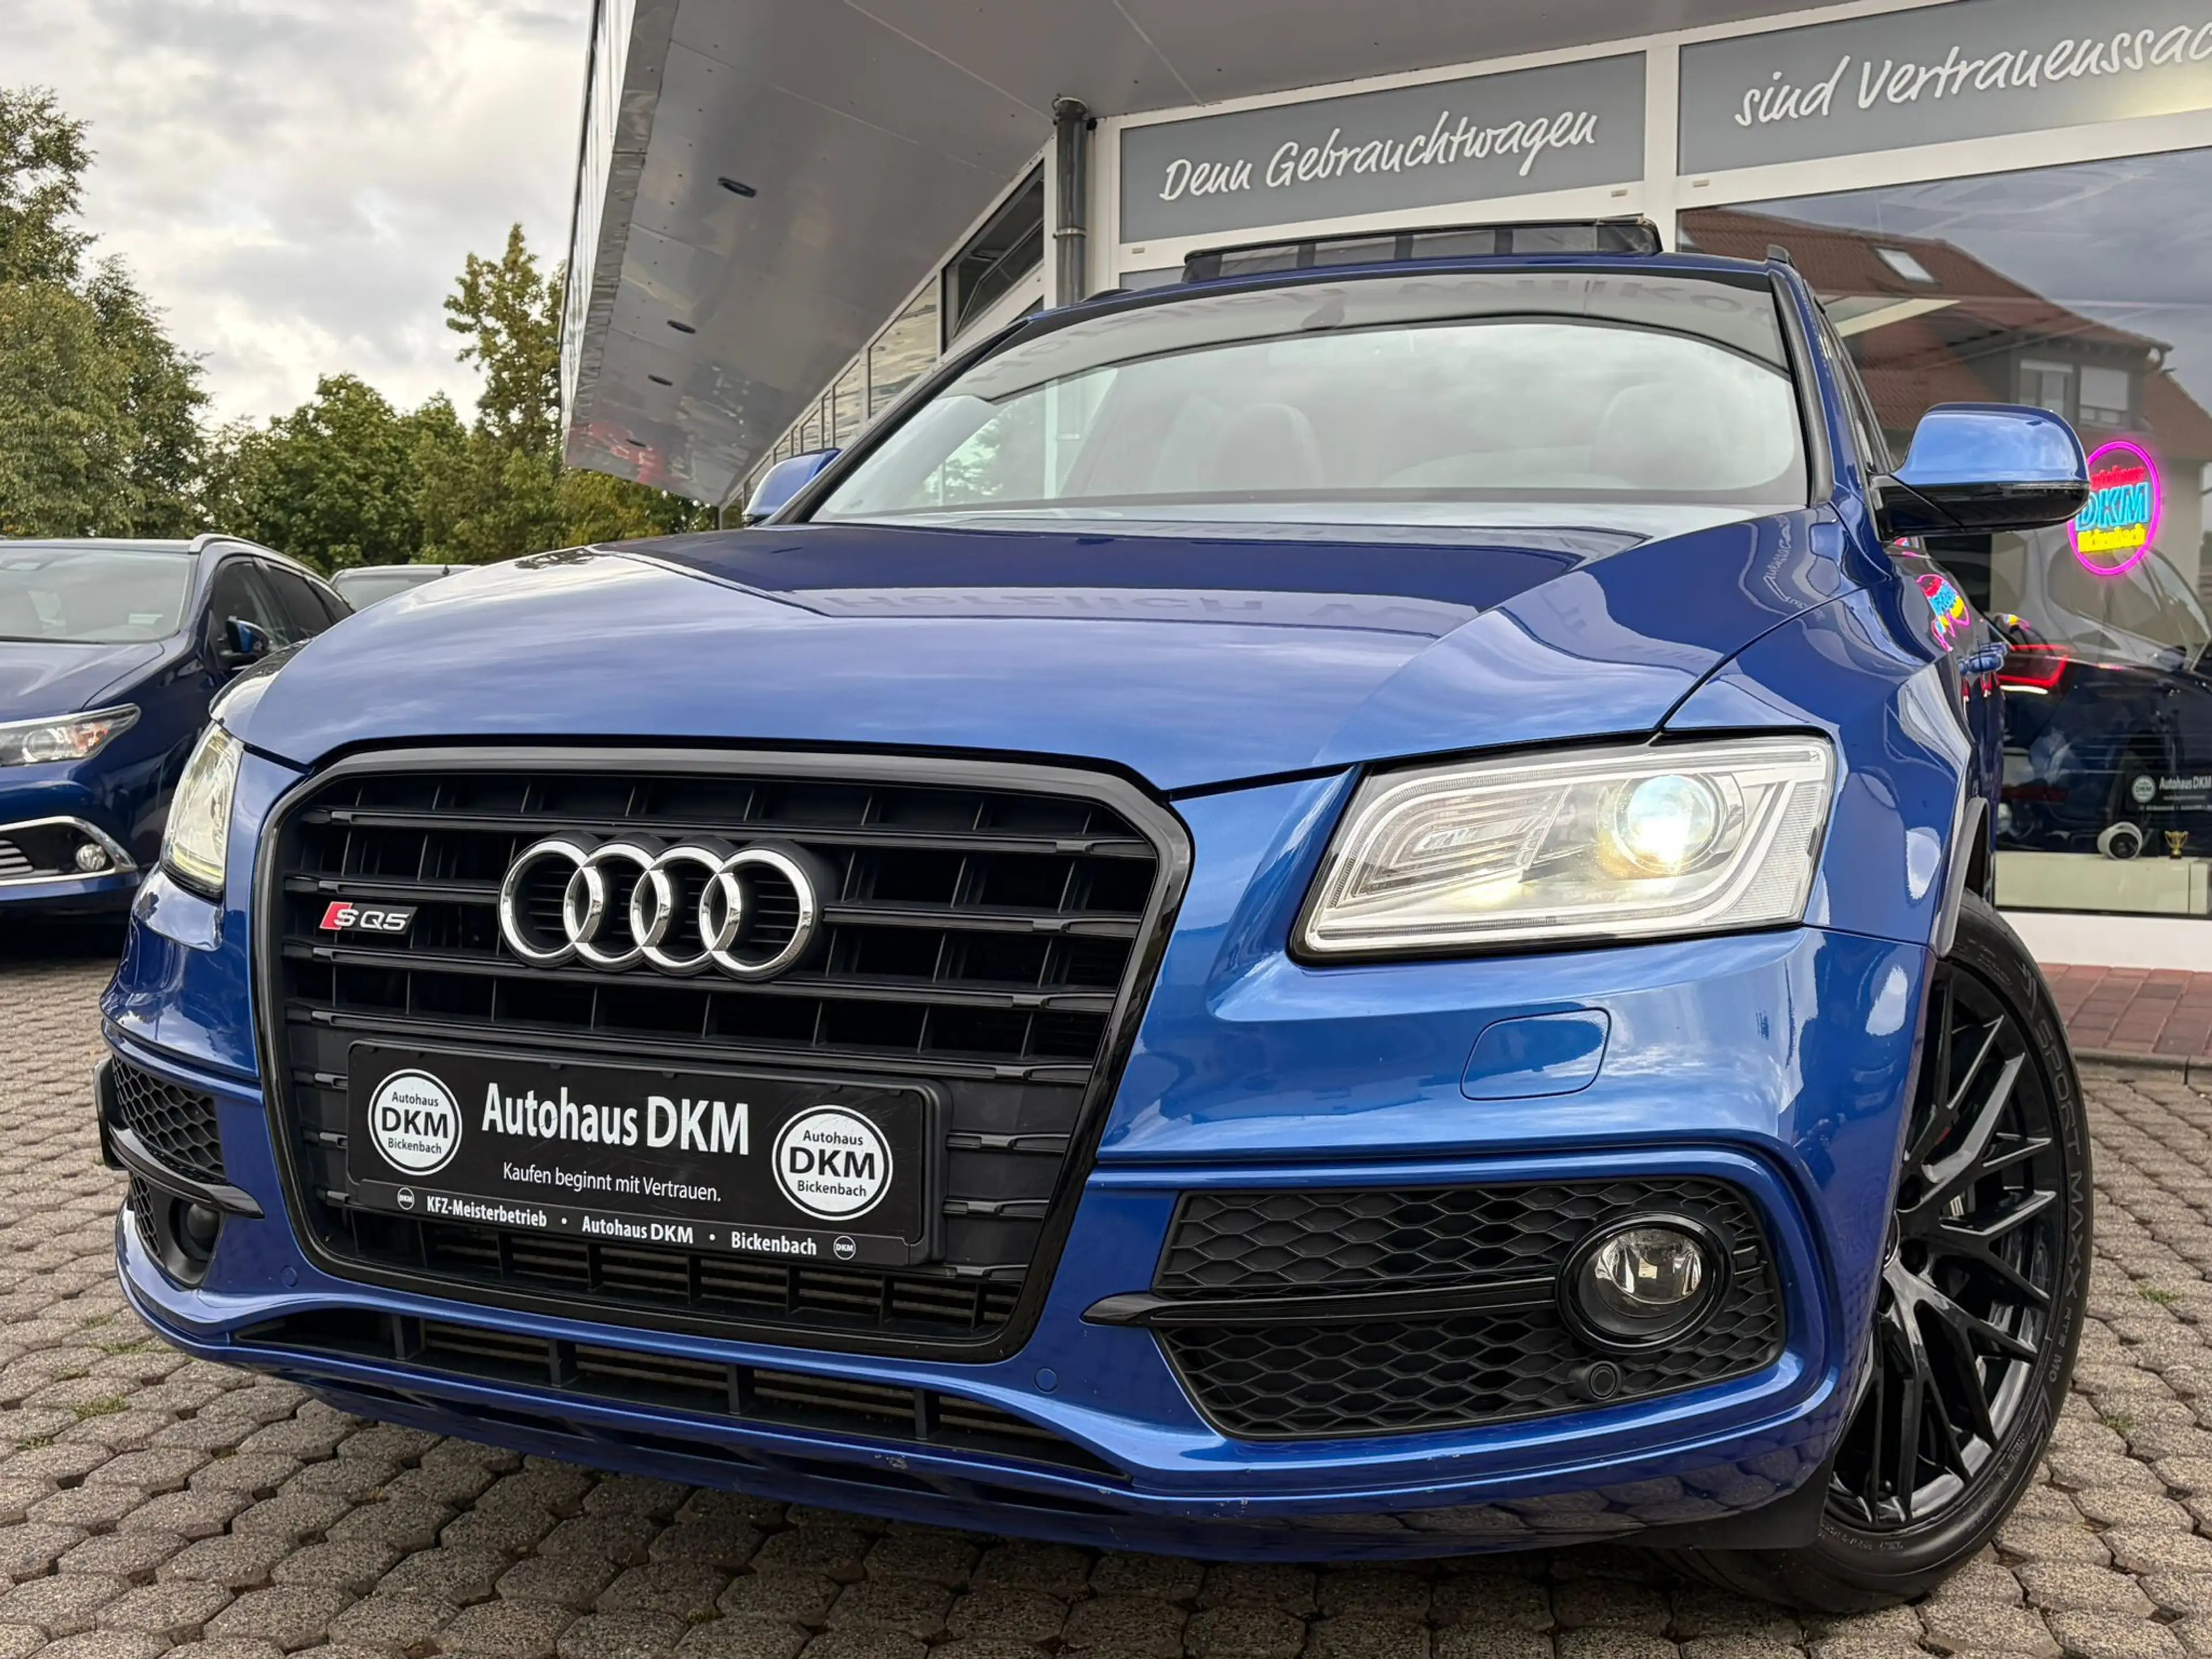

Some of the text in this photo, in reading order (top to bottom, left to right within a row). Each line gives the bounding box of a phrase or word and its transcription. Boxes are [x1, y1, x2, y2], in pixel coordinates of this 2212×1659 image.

[1735, 55, 1850, 126] sind
[1159, 111, 1597, 200] Denn Gebrauchtwagen
[2075, 482, 2150, 531] DKM
[334, 908, 409, 931] SQ5
[392, 1091, 439, 1107] Autohaus
[382, 1107, 448, 1139] DKM
[482, 1082, 749, 1155] Autohaus DKM
[388, 1137, 442, 1154] Bickenbach
[803, 1130, 864, 1146] Autohaus
[789, 1146, 876, 1180] DKM
[2035, 1020, 2081, 1156] SPORT
[2066, 1171, 2083, 1298] MAXX
[503, 1162, 721, 1202] Kaufen beginnt mit Vertrauen.
[797, 1180, 866, 1196] Bickenbach
[426, 1195, 817, 1256] KFZ-Meisterbetrieb Autohaus DKM Bickenbach
[836, 1243, 854, 1253] DKM
